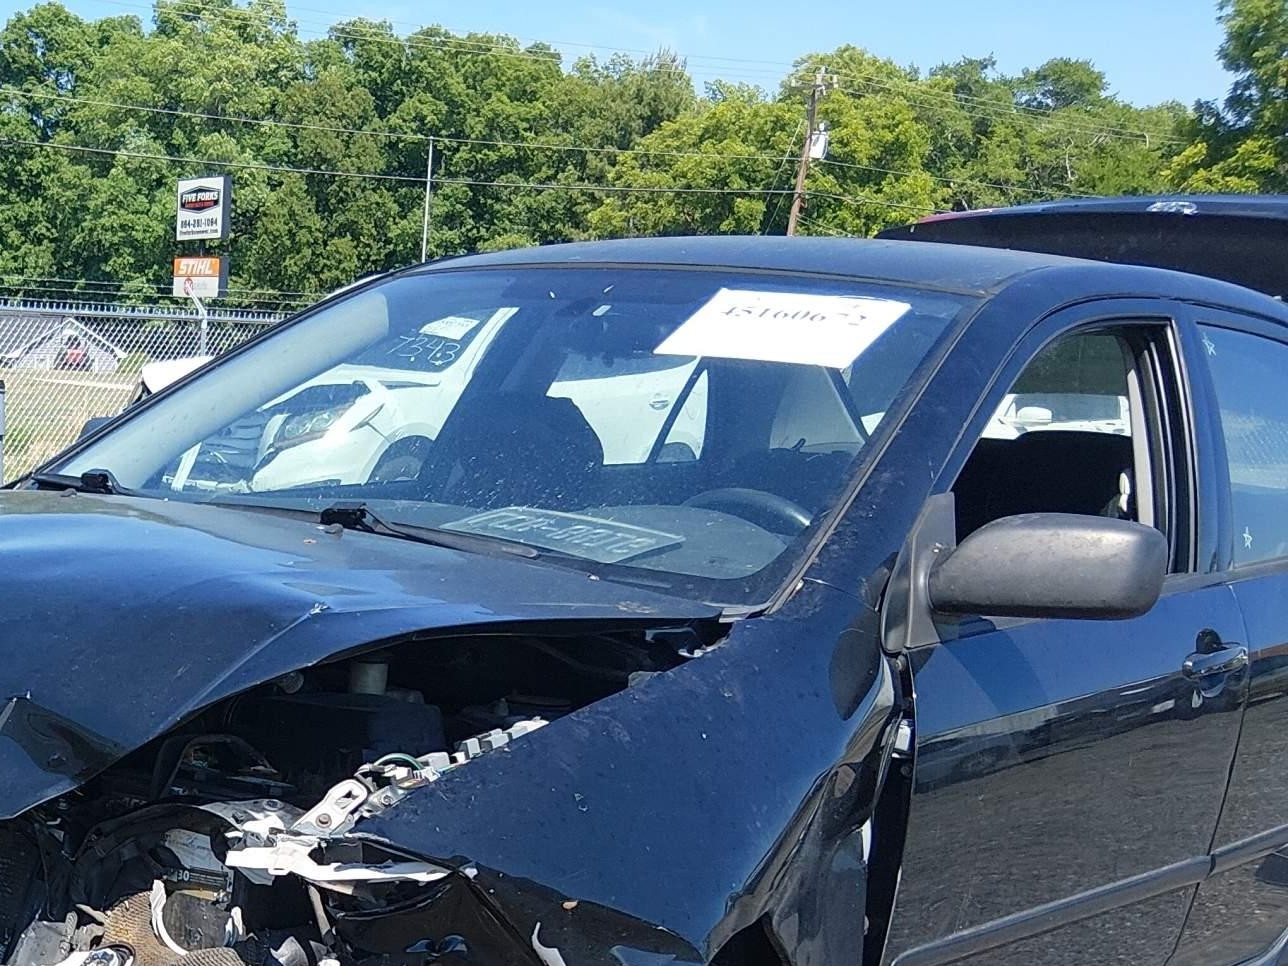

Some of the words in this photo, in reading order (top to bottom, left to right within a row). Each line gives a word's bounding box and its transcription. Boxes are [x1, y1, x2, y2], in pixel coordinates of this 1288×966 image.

[183, 193, 197, 202] FIVE
[197, 191, 218, 201] FORKS
[179, 259, 212, 274] STIHL
